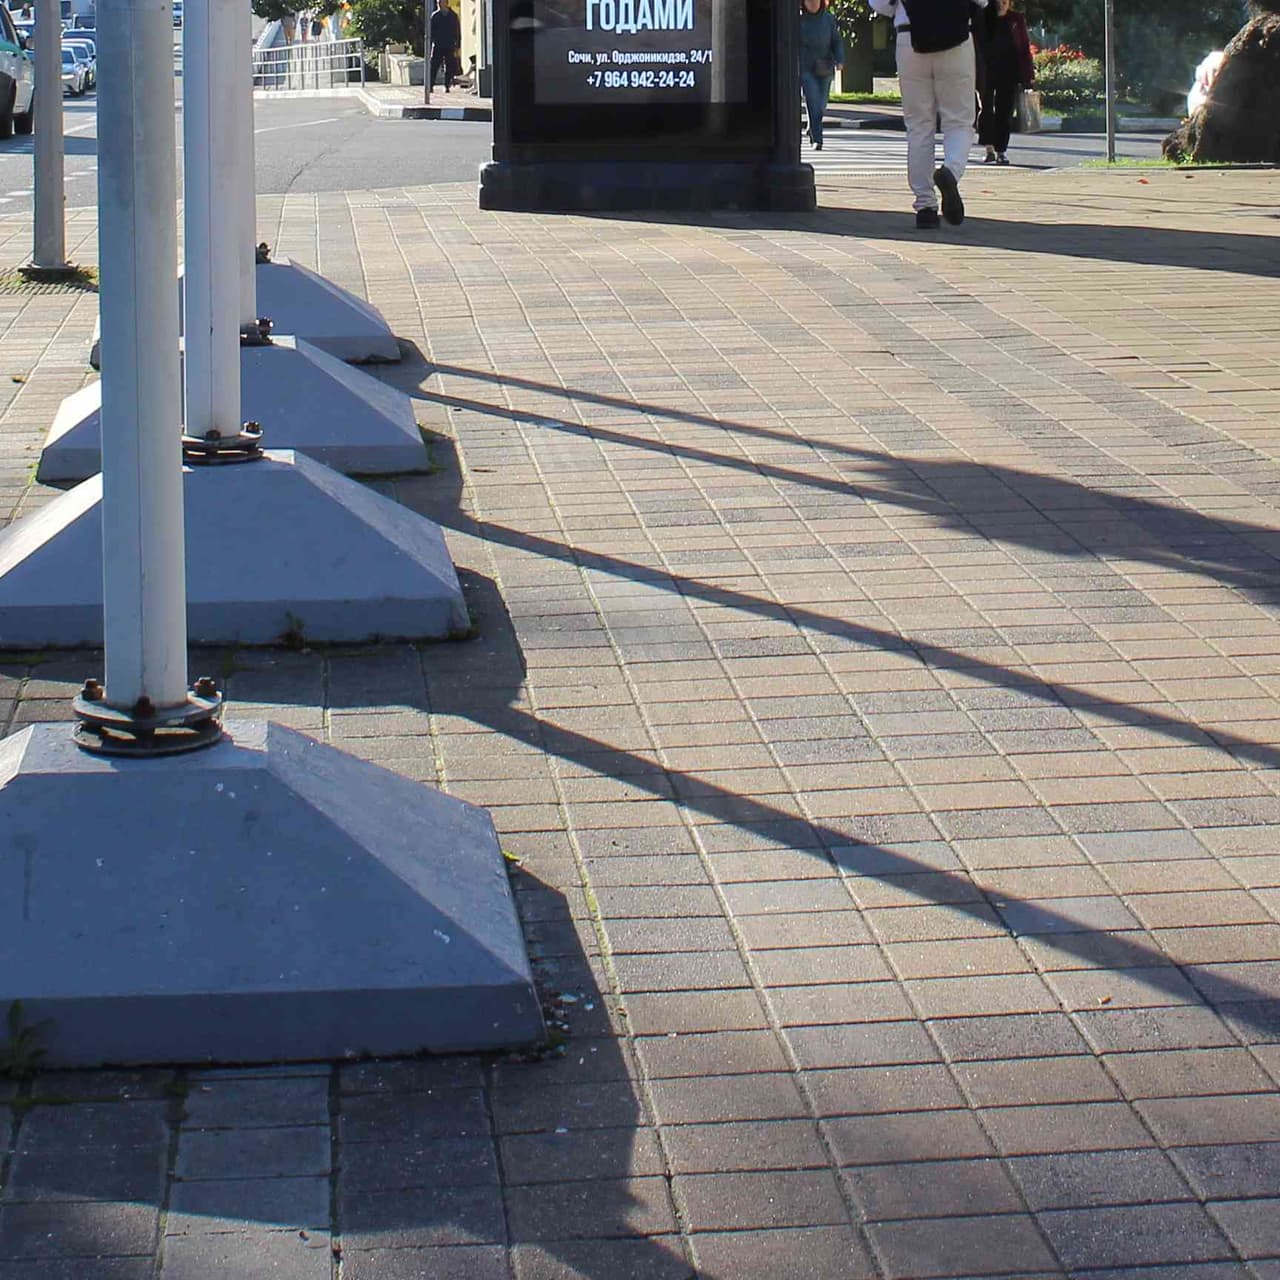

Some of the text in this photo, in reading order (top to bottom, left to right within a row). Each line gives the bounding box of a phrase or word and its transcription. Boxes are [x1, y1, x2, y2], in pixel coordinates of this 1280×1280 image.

[568, 50, 713, 65] Сочи, ул. Орджоникидзе, 24/1
[587, 71, 695, 87] +7 964 942-24-24
